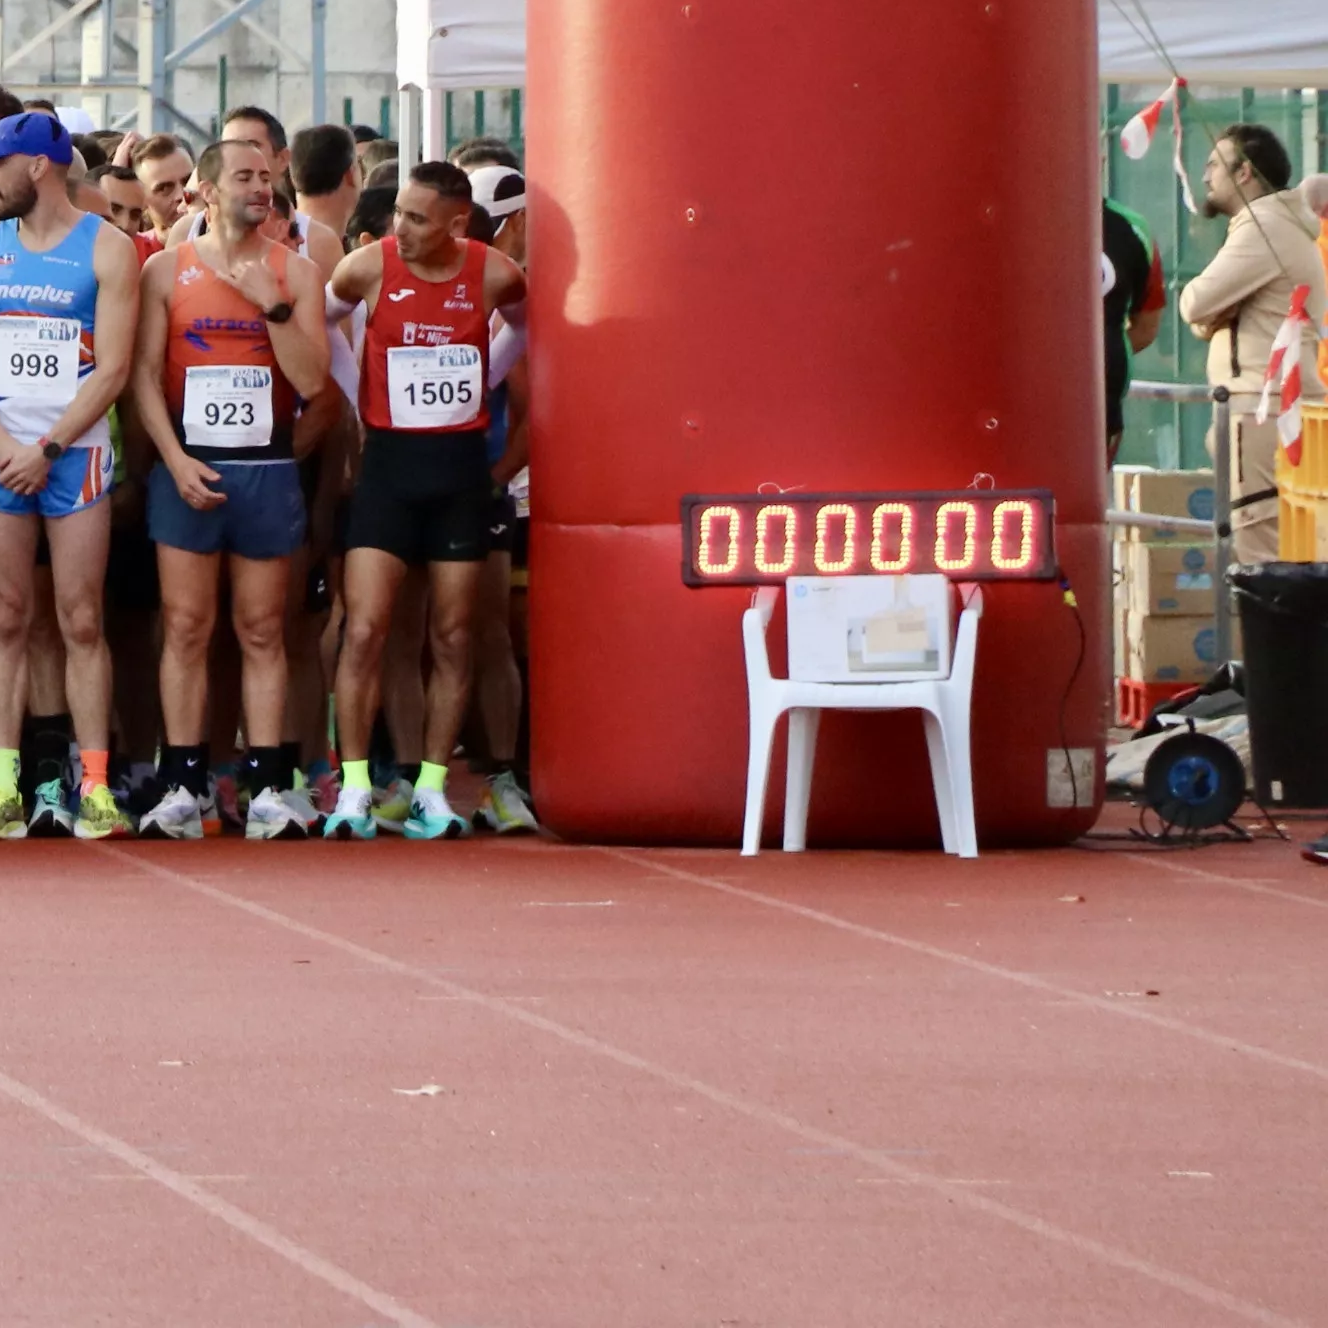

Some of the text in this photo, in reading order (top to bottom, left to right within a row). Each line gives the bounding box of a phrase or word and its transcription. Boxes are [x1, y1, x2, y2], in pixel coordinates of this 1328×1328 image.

[10, 353, 59, 377] 998
[404, 380, 472, 406] 1505
[205, 402, 254, 425] 923
